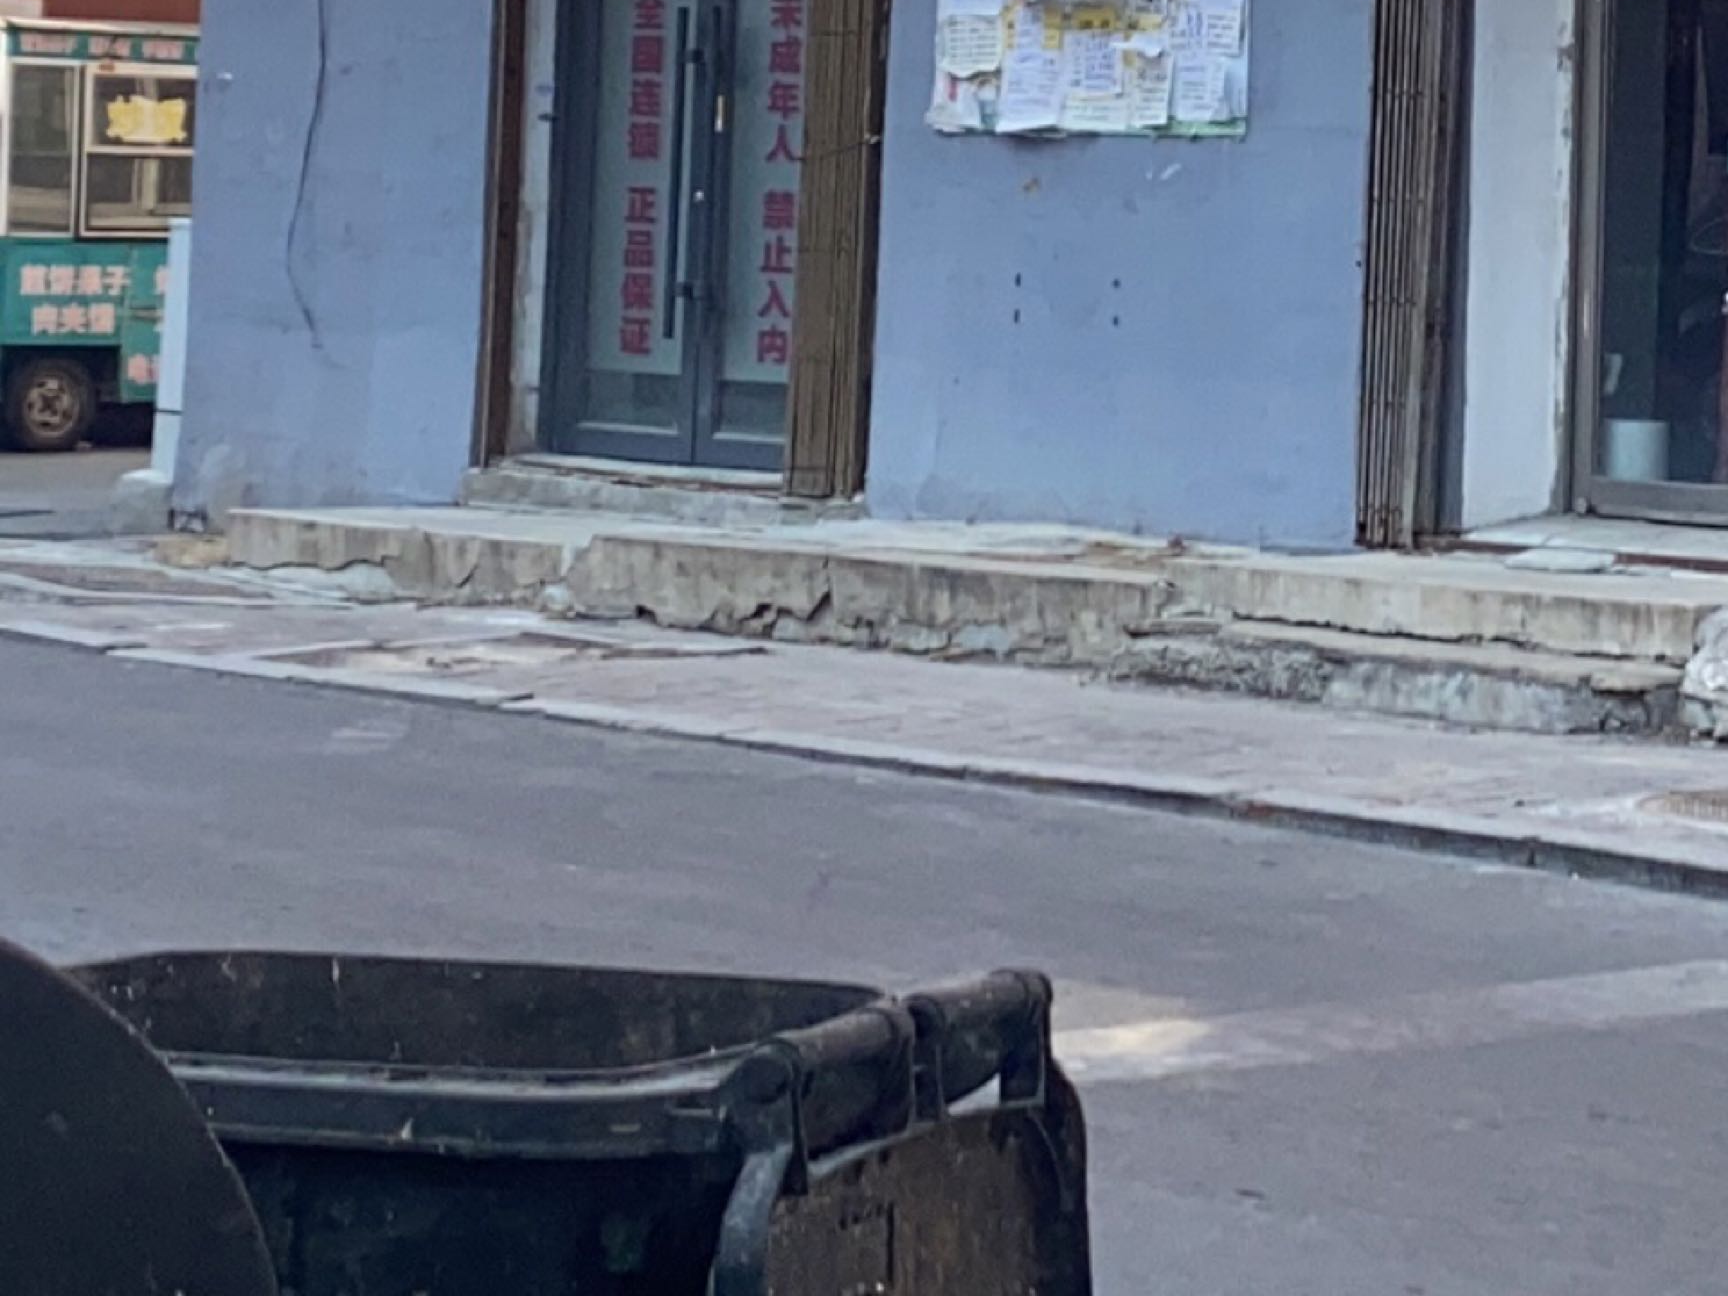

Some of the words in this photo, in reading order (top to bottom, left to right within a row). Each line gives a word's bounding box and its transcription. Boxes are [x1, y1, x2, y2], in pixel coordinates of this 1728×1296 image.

[618, 187, 658, 356] 正品保证
[756, 190, 796, 365] 禁止入内
